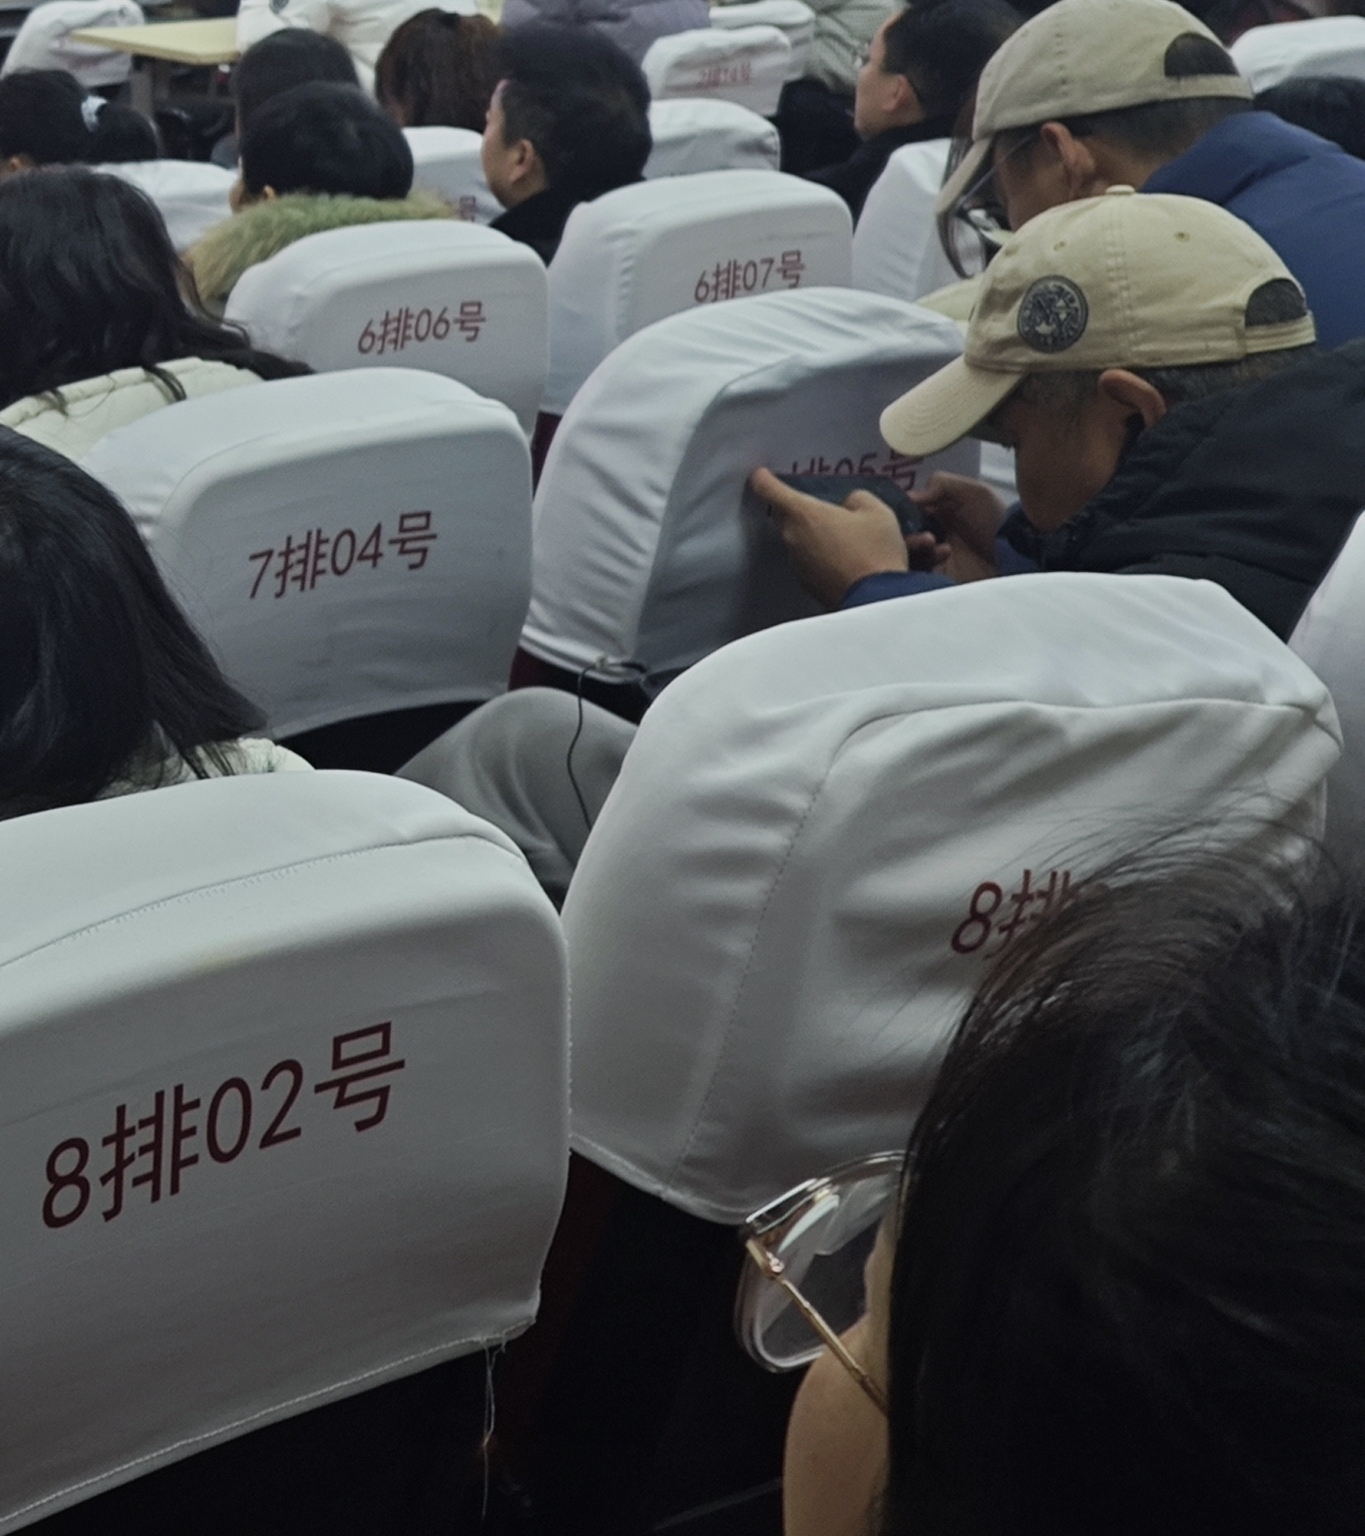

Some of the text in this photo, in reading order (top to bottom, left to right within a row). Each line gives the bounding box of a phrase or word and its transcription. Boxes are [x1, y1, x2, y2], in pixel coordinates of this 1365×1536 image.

[694, 249, 805, 303] 6排07号
[357, 301, 486, 355] 6排06号
[248, 511, 437, 599] 7排04号
[42, 1021, 405, 1229] 8排02号
